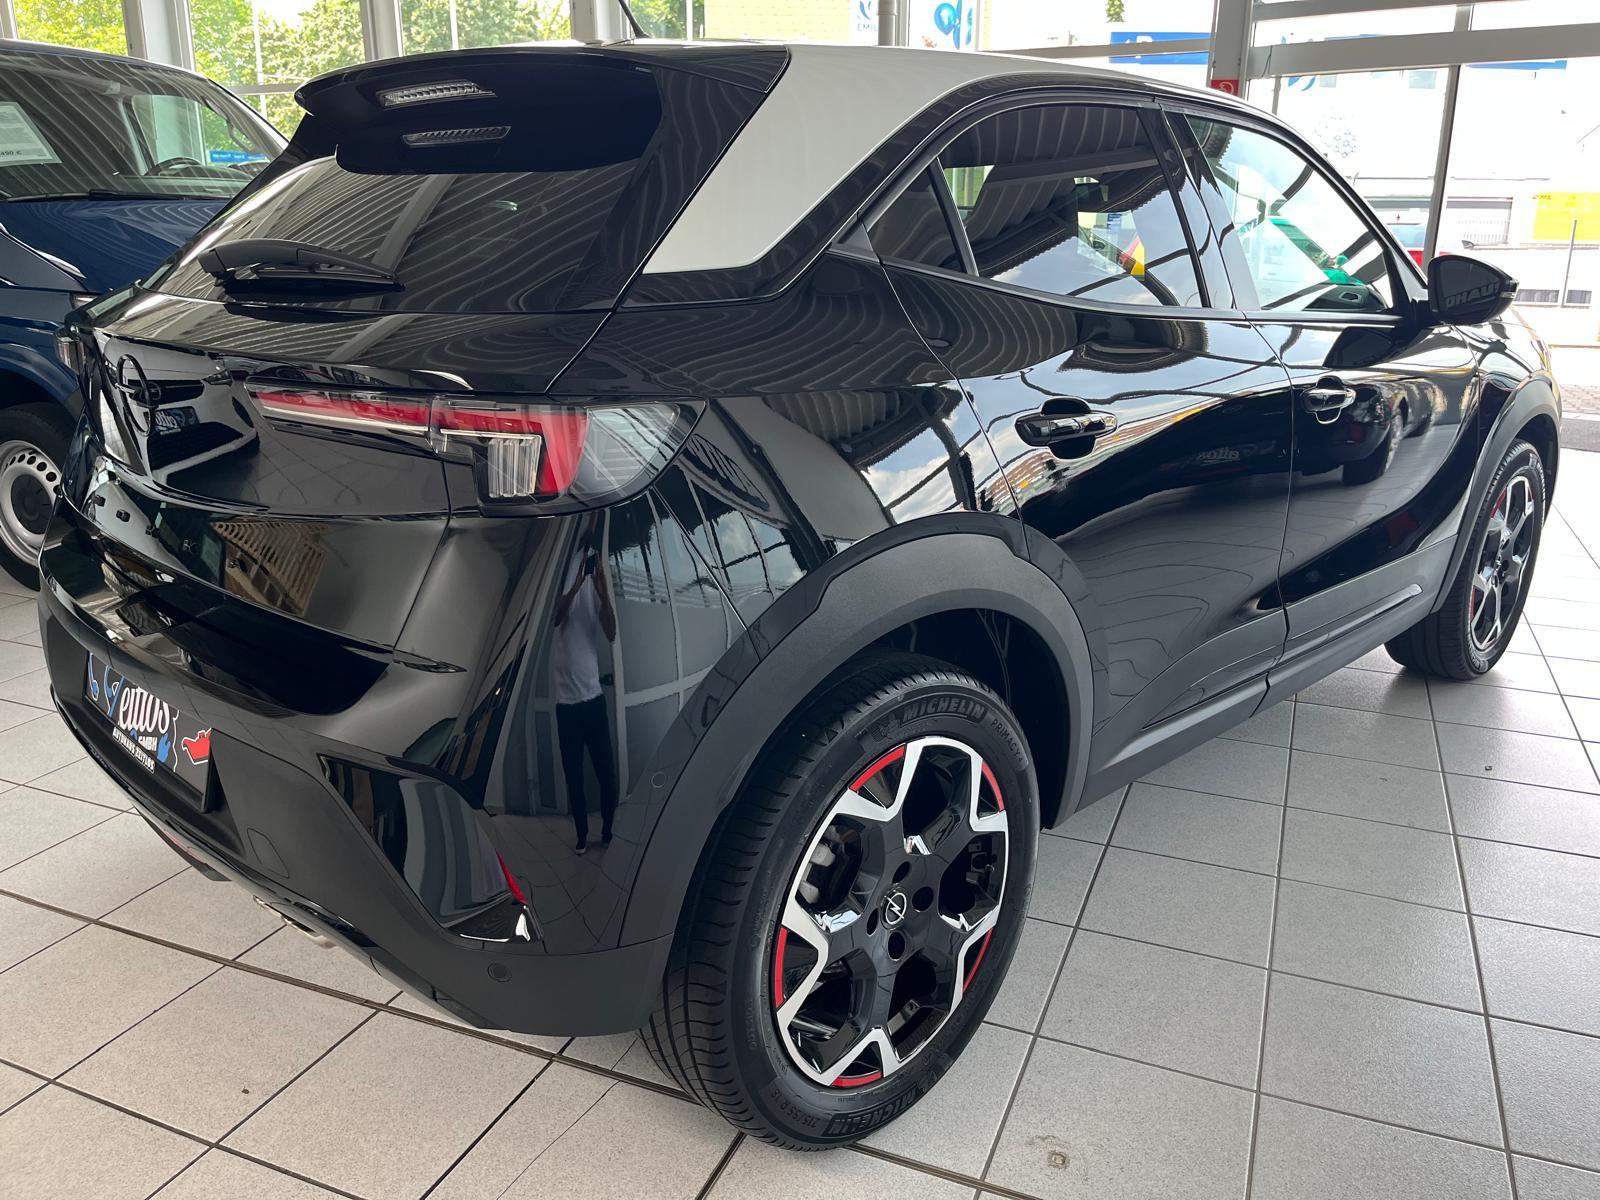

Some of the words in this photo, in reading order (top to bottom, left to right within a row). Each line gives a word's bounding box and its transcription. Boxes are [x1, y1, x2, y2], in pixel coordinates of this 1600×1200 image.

[903, 699, 985, 723] MICHELIN
[991, 718, 1021, 757] PRIMACY
[828, 1086, 917, 1135] MICHELIN
